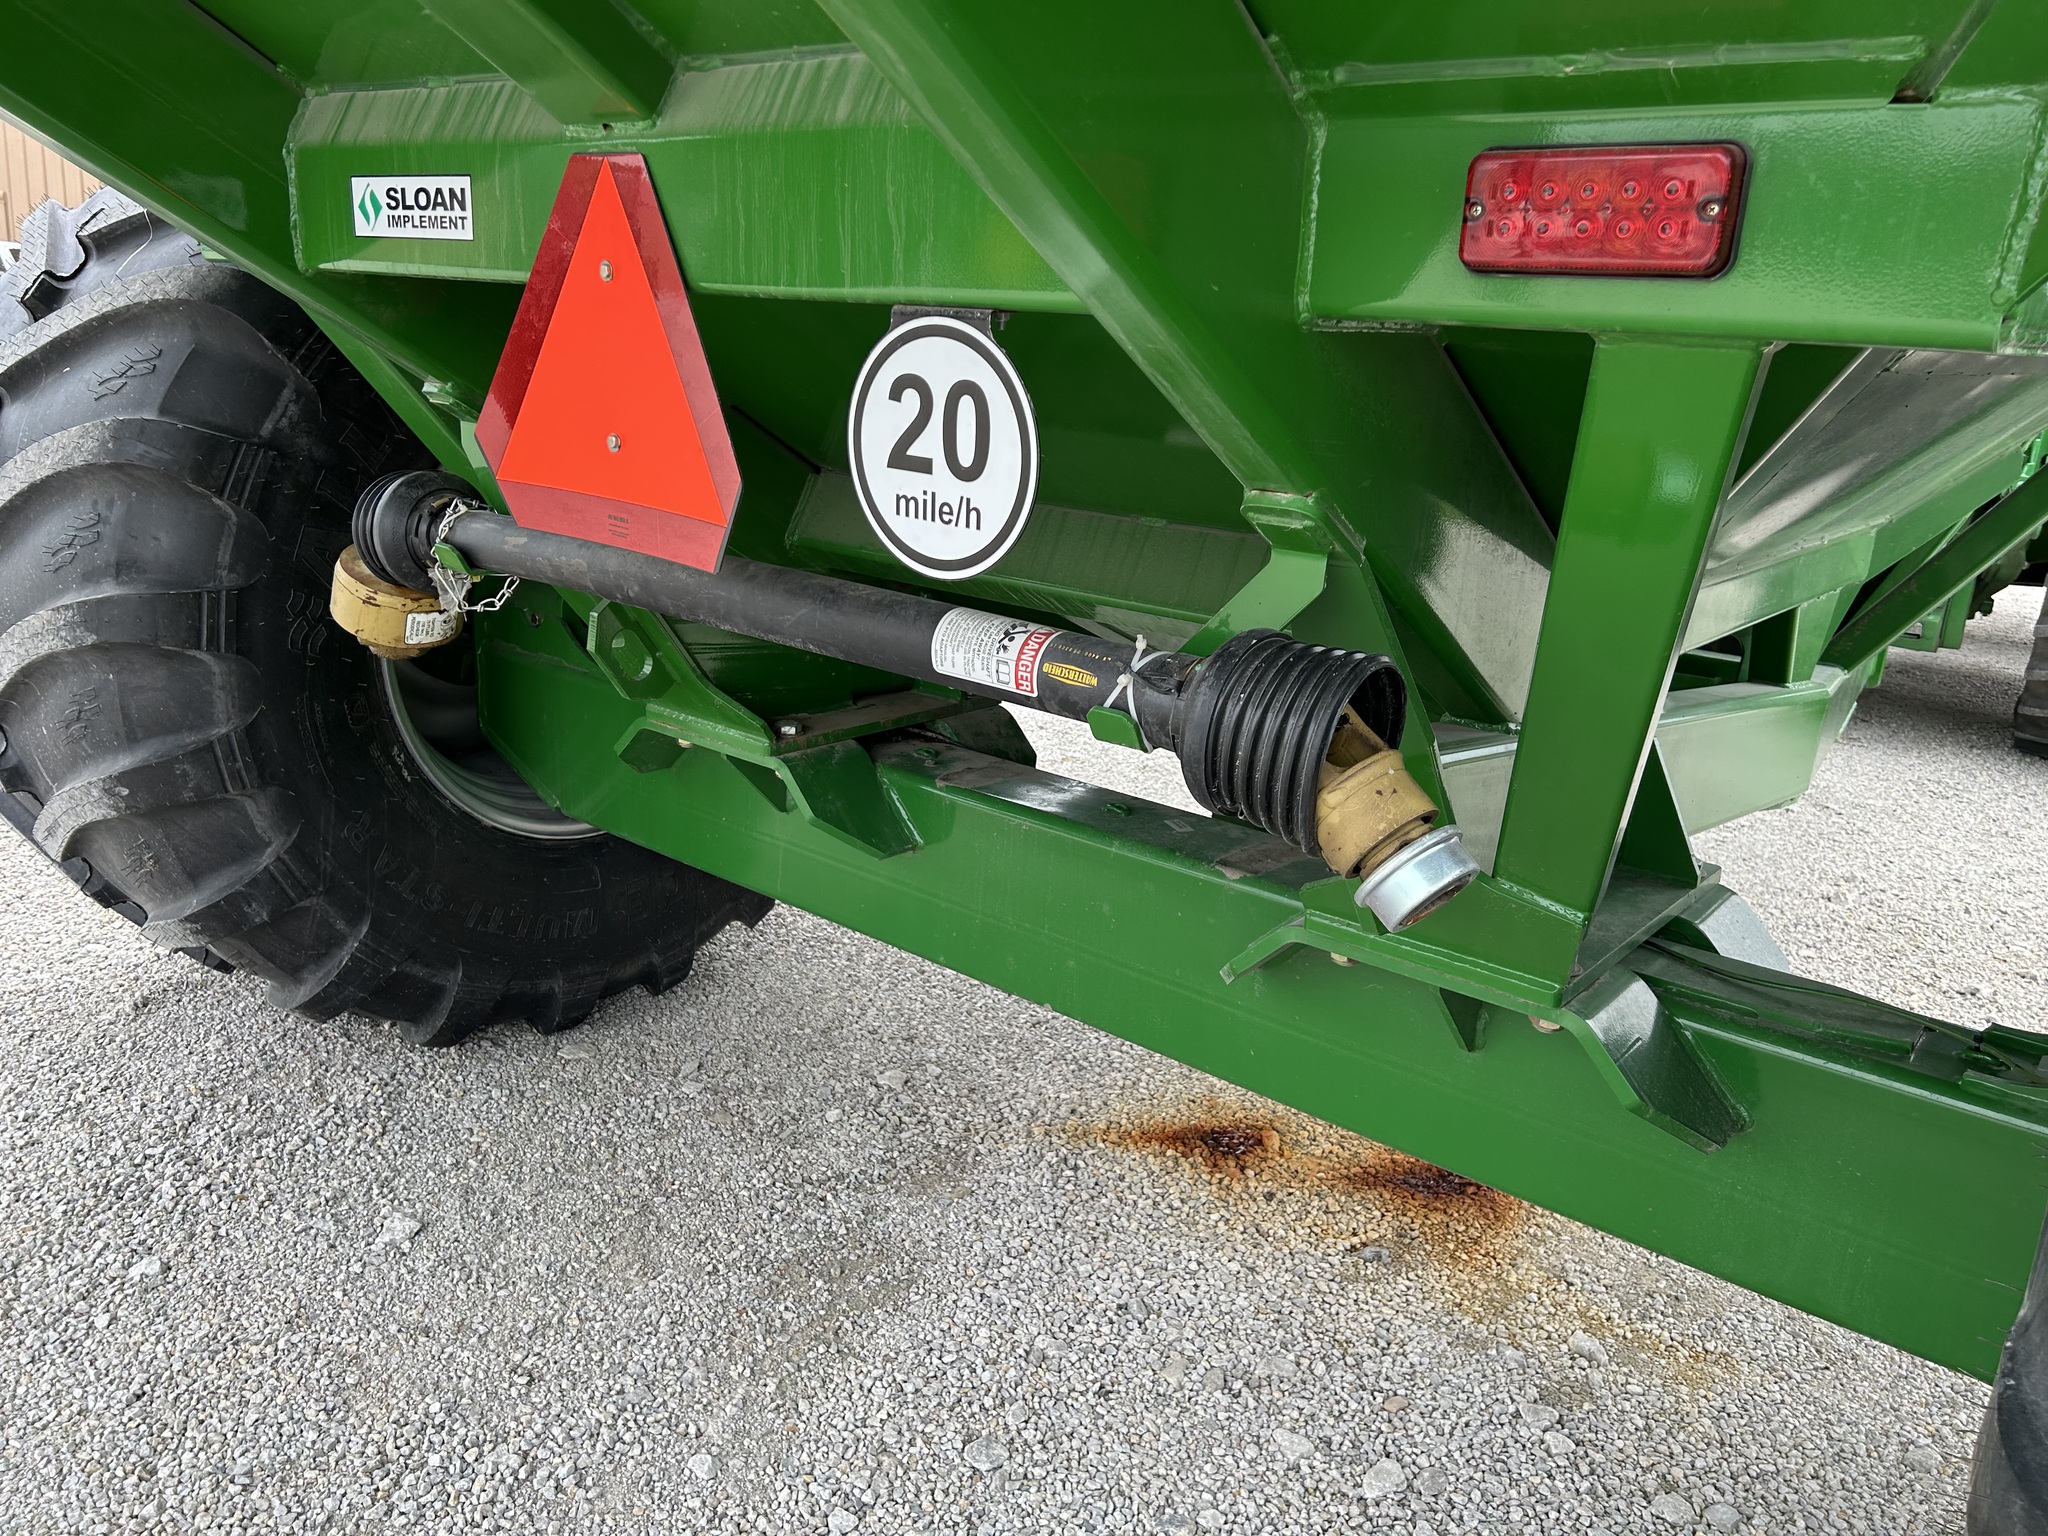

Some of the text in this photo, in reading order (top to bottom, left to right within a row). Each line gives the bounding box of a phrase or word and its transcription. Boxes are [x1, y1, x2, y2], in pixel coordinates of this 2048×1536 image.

[385, 186, 467, 212] SLOAN
[387, 214, 468, 230] IMPLEMENT
[887, 373, 991, 482] 20
[895, 490, 981, 531] mile/h
[983, 622, 994, 637] KEEP
[1017, 632, 1047, 691] DANGER
[1042, 662, 1098, 687] WALTERSCHEID
